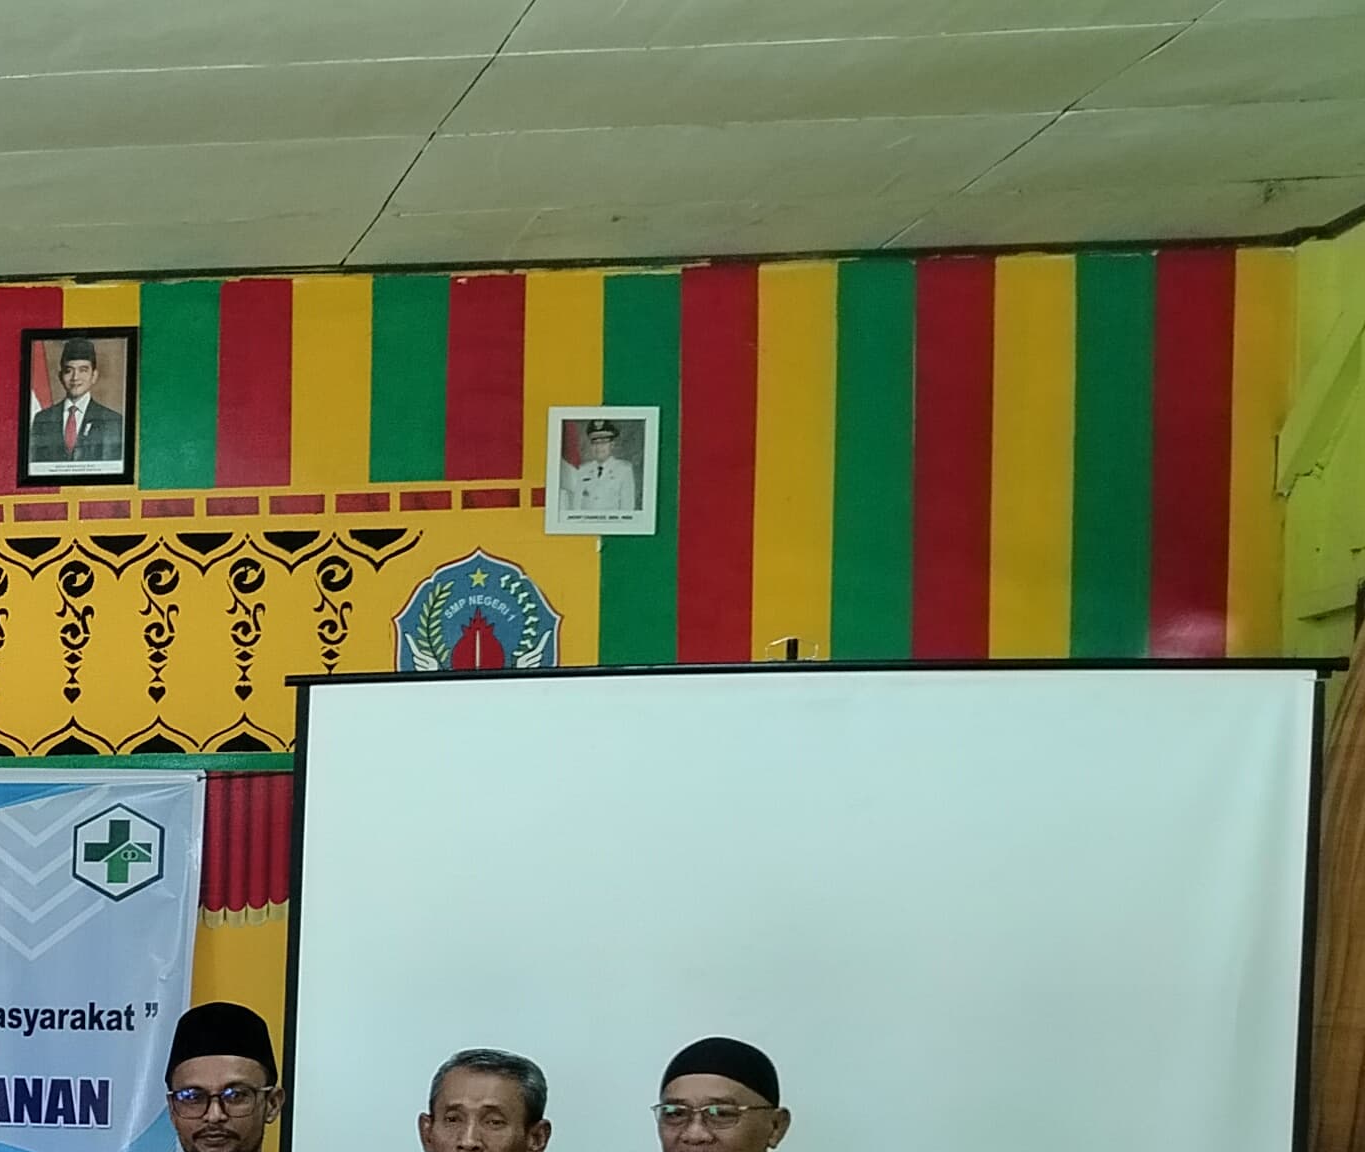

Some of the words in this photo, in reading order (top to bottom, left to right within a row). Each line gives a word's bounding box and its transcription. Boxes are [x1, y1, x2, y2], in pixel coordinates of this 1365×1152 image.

[444, 598, 466, 619] SMP
[468, 594, 510, 615] NEGERI
[507, 614, 517, 622] 1
